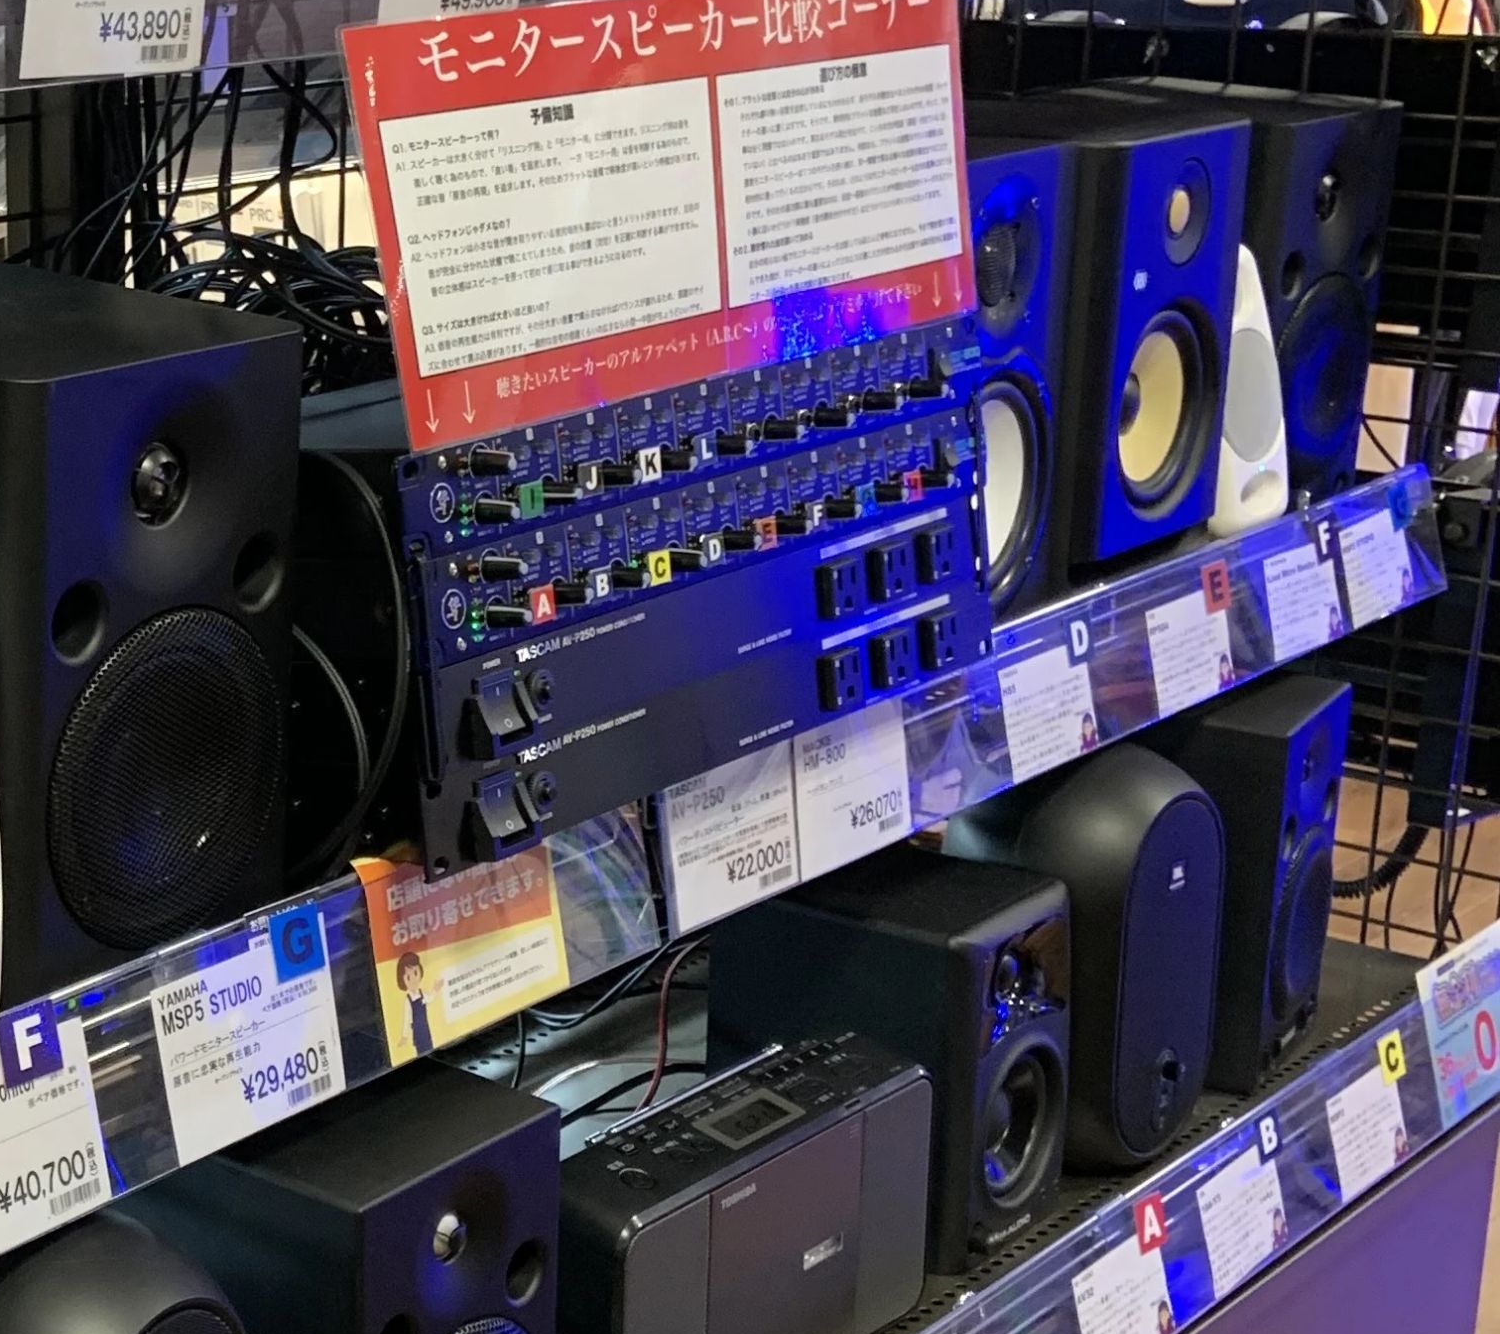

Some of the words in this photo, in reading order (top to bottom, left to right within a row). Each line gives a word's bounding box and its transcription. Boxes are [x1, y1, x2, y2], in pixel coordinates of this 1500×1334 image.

[99, 9, 181, 43] ¥43,890
[530, 103, 575, 126] 予備知識
[643, 451, 658, 477] K
[701, 438, 713, 460] L
[586, 466, 597, 490] J
[812, 504, 823, 526] F
[708, 538, 721, 561] D
[1318, 521, 1330, 554] F
[654, 557, 667, 579] C
[596, 574, 609, 597] B
[1208, 573, 1223, 604] E
[538, 594, 552, 618] A
[516, 637, 561, 663] TASCAM
[562, 627, 596, 646] AV-P250
[1070, 620, 1089, 656] D
[518, 737, 562, 764] TASCAM
[563, 724, 597, 745] AV-P250
[804, 743, 846, 773] HM-800
[672, 786, 725, 822] AV-P250
[850, 791, 897, 830] ¥26,070
[726, 841, 785, 885] ¥22,000
[391, 870, 544, 946] お取り寄せできます。
[282, 918, 313, 964] G
[158, 979, 208, 1009] YAMAHA
[162, 1000, 205, 1036] MSP5
[209, 975, 262, 1015] STUDIO
[12, 1013, 43, 1072] F
[1386, 1044, 1399, 1072] C
[241, 1047, 318, 1104] ¥29,480
[1260, 1117, 1278, 1152] B
[1143, 1204, 1162, 1243] A
